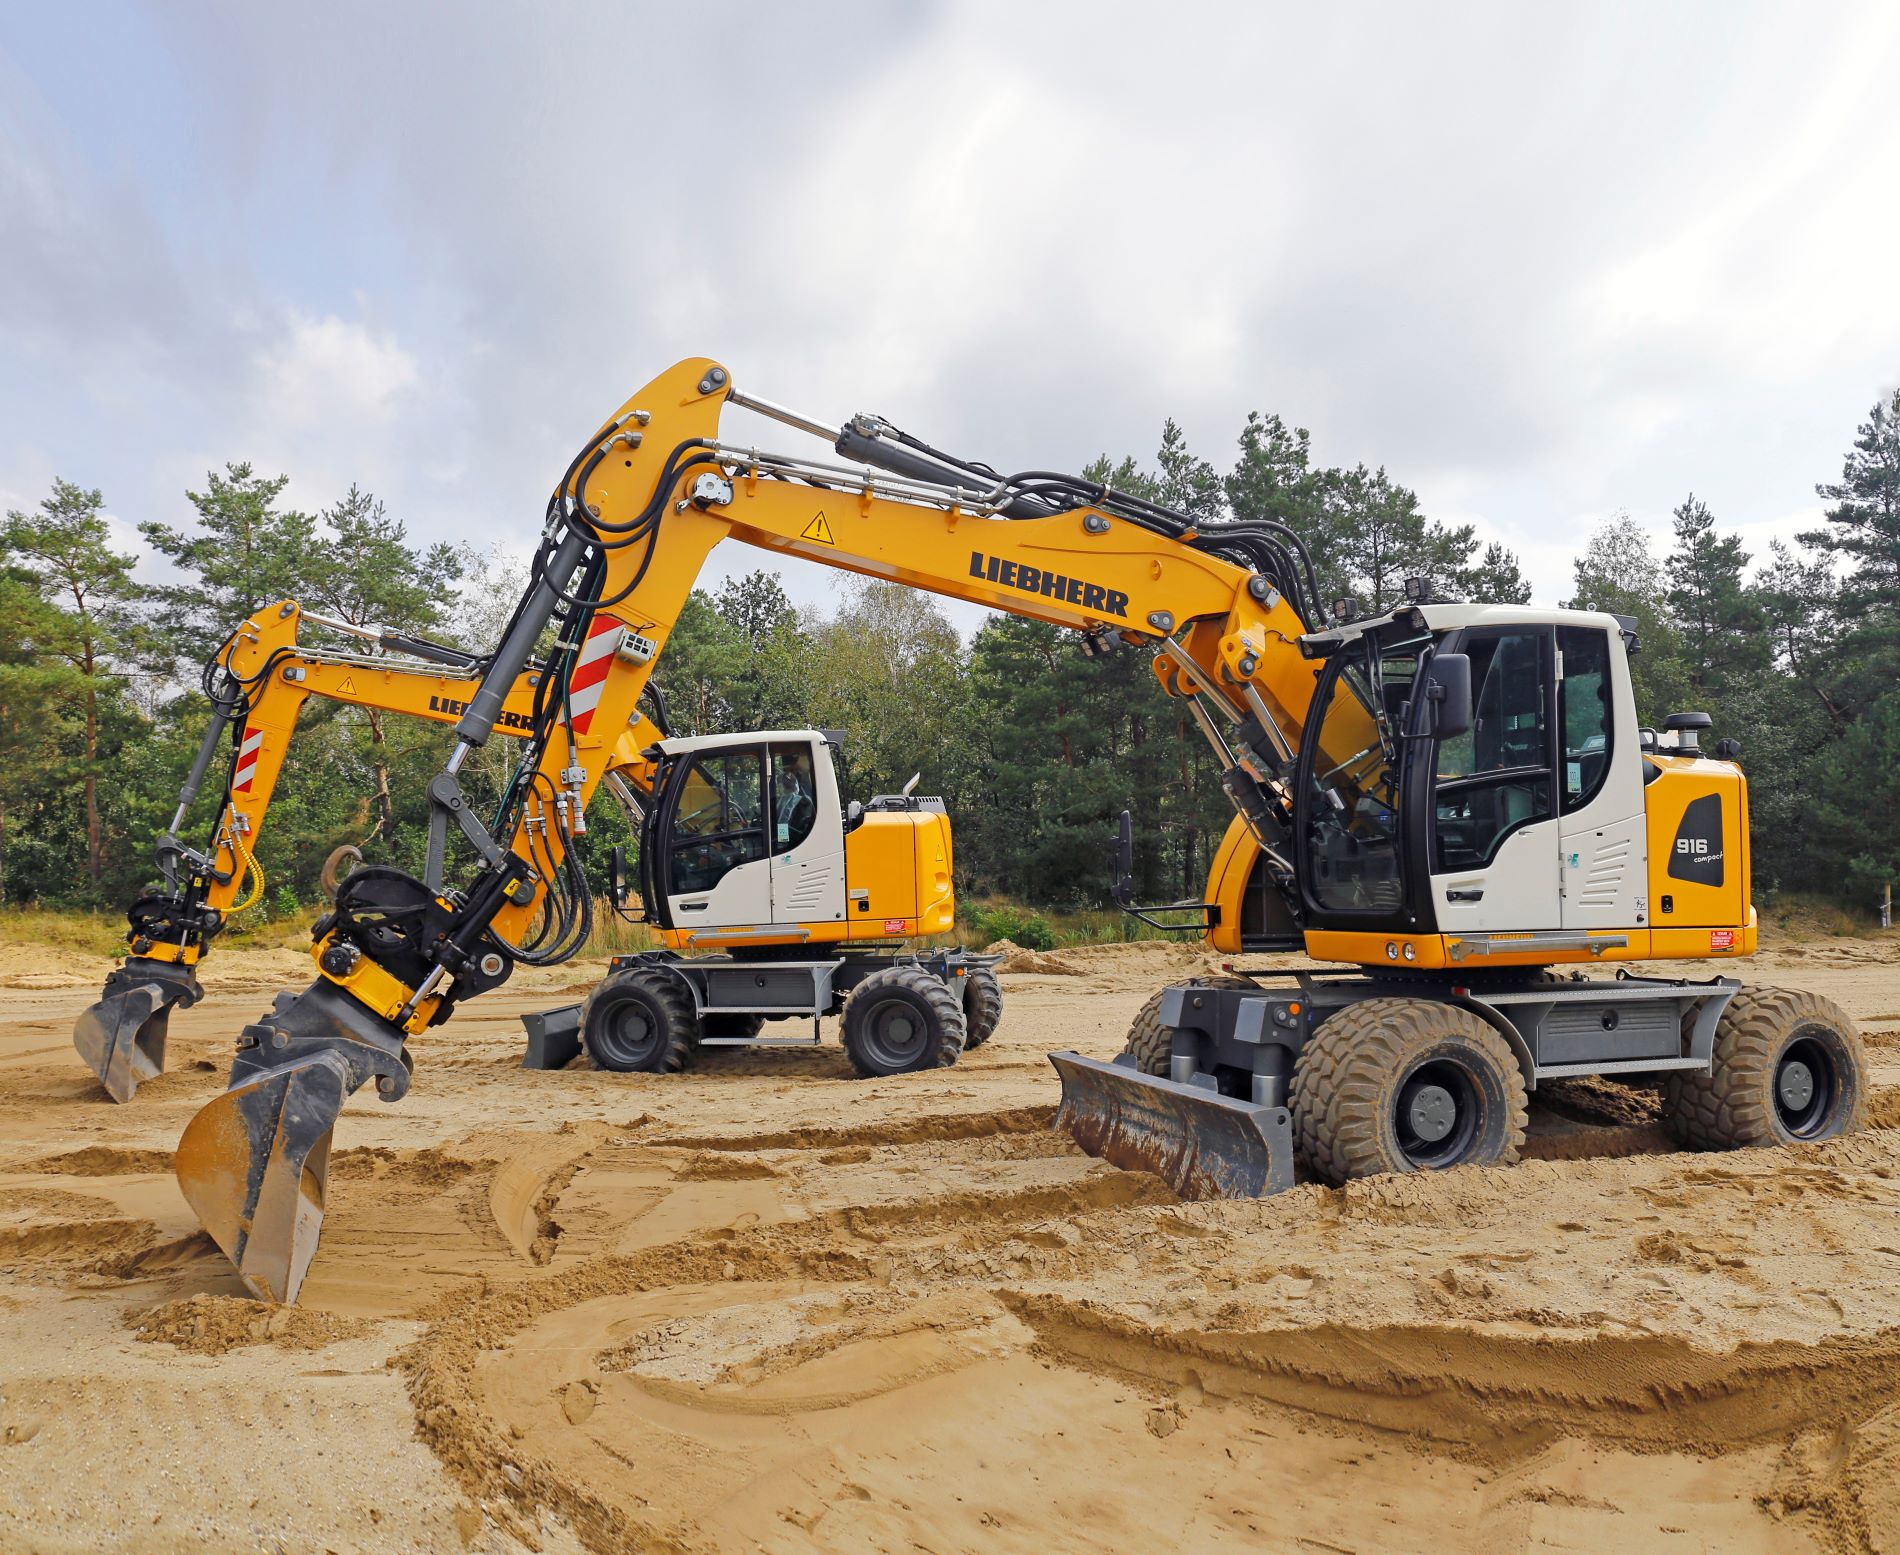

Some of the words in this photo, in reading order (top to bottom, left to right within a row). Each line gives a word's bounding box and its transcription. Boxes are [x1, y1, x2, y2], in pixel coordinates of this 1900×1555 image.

[969, 551, 1129, 618] LIEBHERR
[1677, 838, 1708, 854] 916
[1693, 851, 1723, 863] compact
